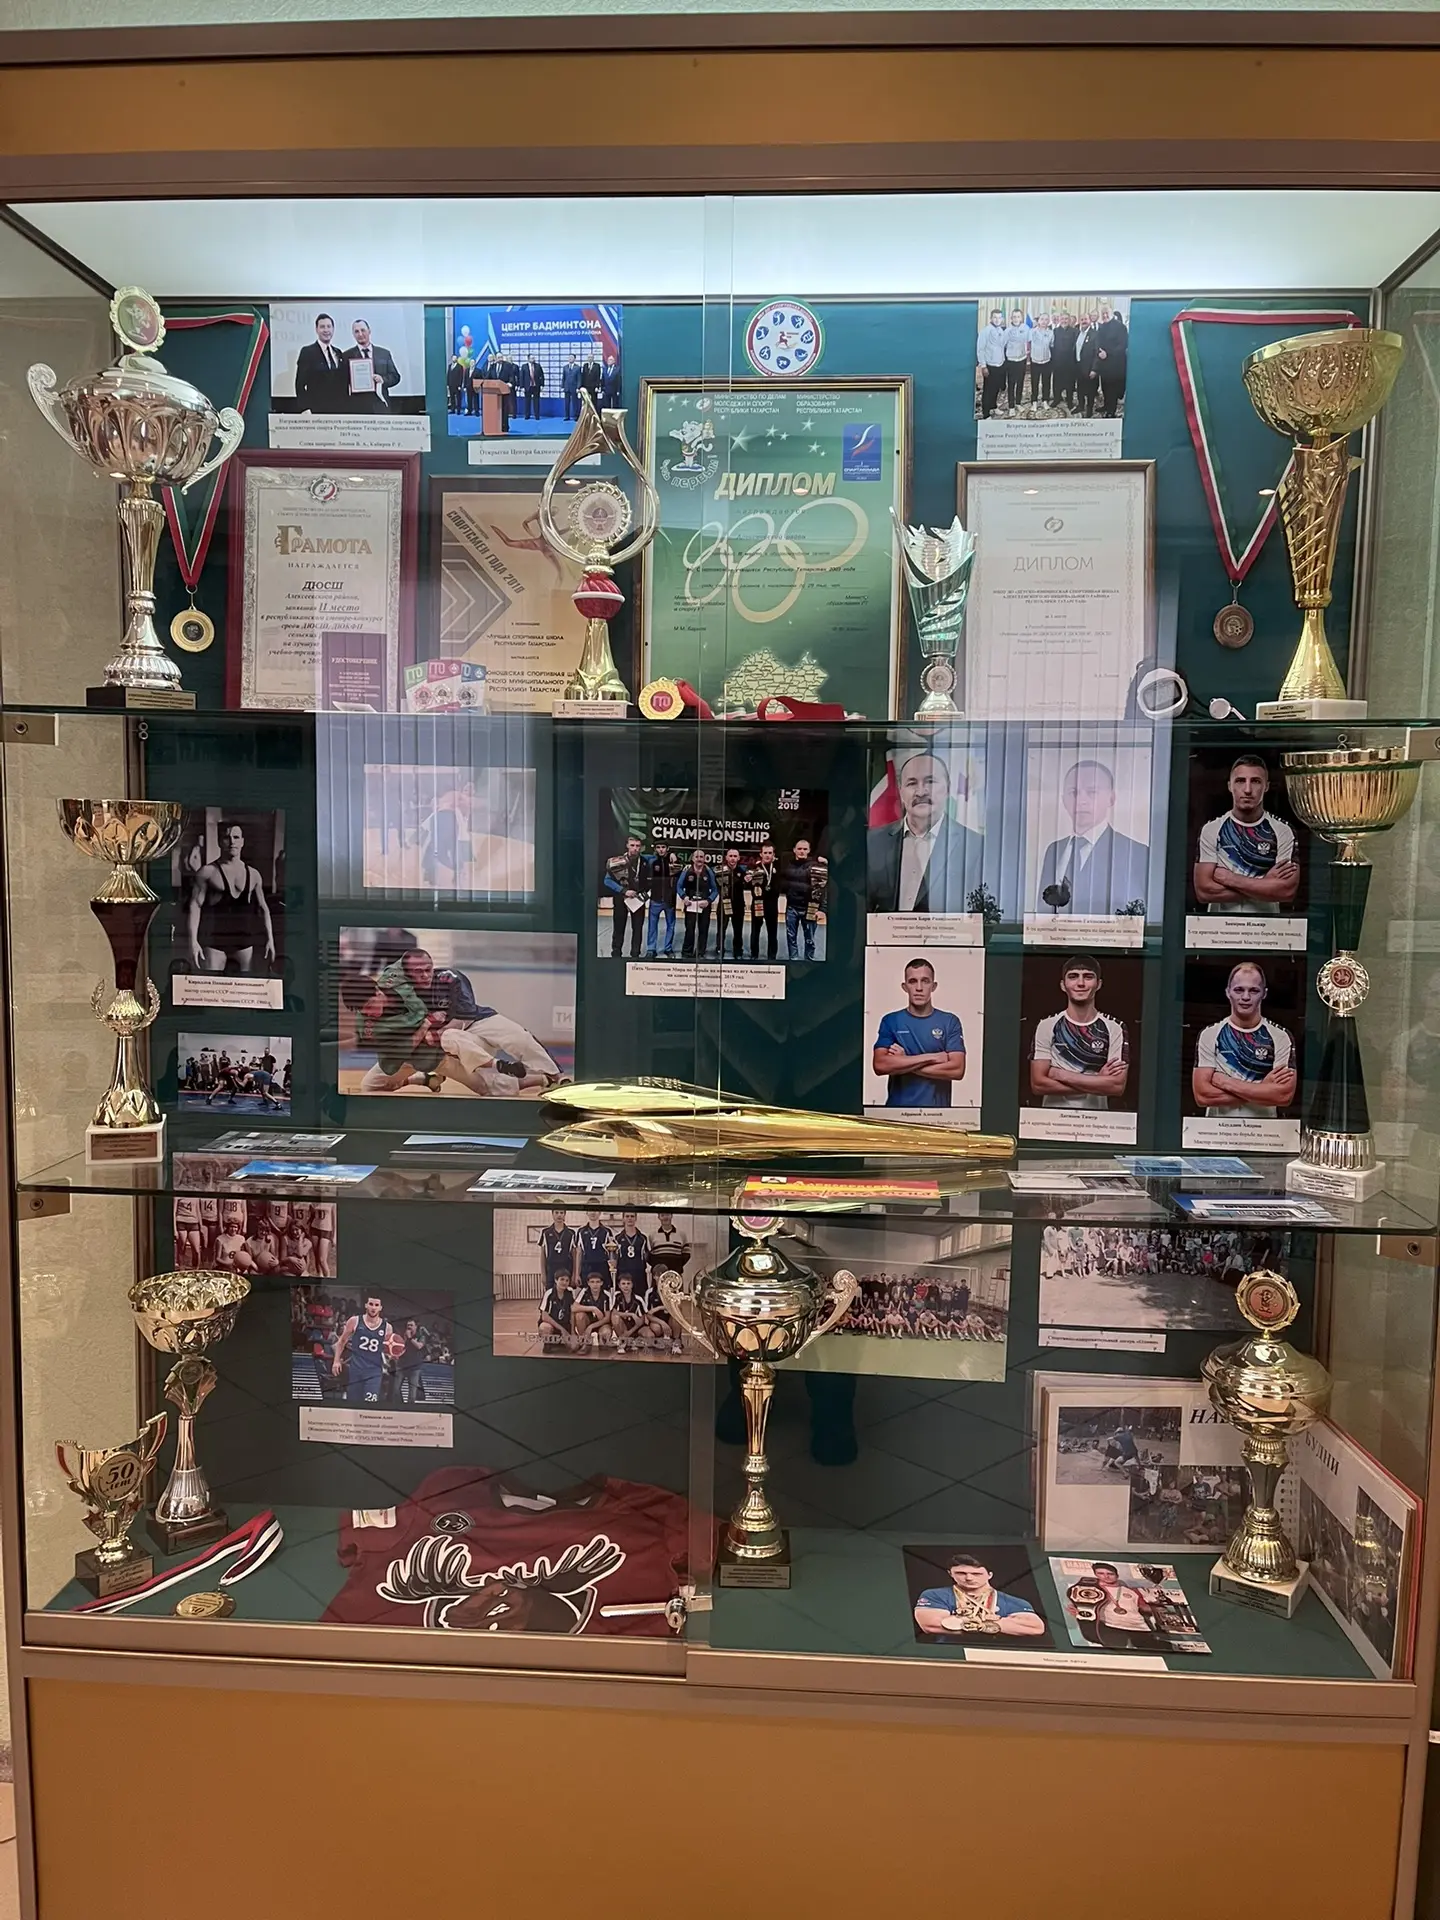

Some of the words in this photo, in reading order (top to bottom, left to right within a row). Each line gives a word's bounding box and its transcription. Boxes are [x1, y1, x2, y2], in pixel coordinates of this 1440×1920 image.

[502, 322, 530, 332] ЦЕНТР
[532, 320, 602, 330] БАДМИНТОНА
[714, 472, 836, 500] ДИПЛОМ
[274, 525, 372, 556] ГРАМОТА
[446, 510, 490, 555] СПОРТСМЕН
[485, 552, 507, 576] ГОДА
[288, 562, 360, 570] НАГРАЖДАЕТСЯ
[1013, 556, 1094, 573] ДИПЛОМ
[302, 580, 344, 592] ДЮСШ
[330, 604, 360, 612] место
[778, 802, 800, 810] 2019
[652, 816, 688, 826] WORLD
[690, 819, 713, 828] BELT
[714, 820, 770, 830] WRESTLING
[652, 826, 770, 843] CHAMPIONSHIP
[185, 1201, 192, 1212] 4
[204, 1200, 213, 1211] 14
[274, 1205, 281, 1216] 9
[554, 1241, 562, 1253] 4
[590, 1237, 598, 1249] 7
[627, 1246, 635, 1257] 8
[359, 1336, 380, 1352] 28
[364, 1392, 378, 1402] 28
[1305, 1431, 1340, 1476] БУДНИ
[106, 1462, 134, 1484] 50
